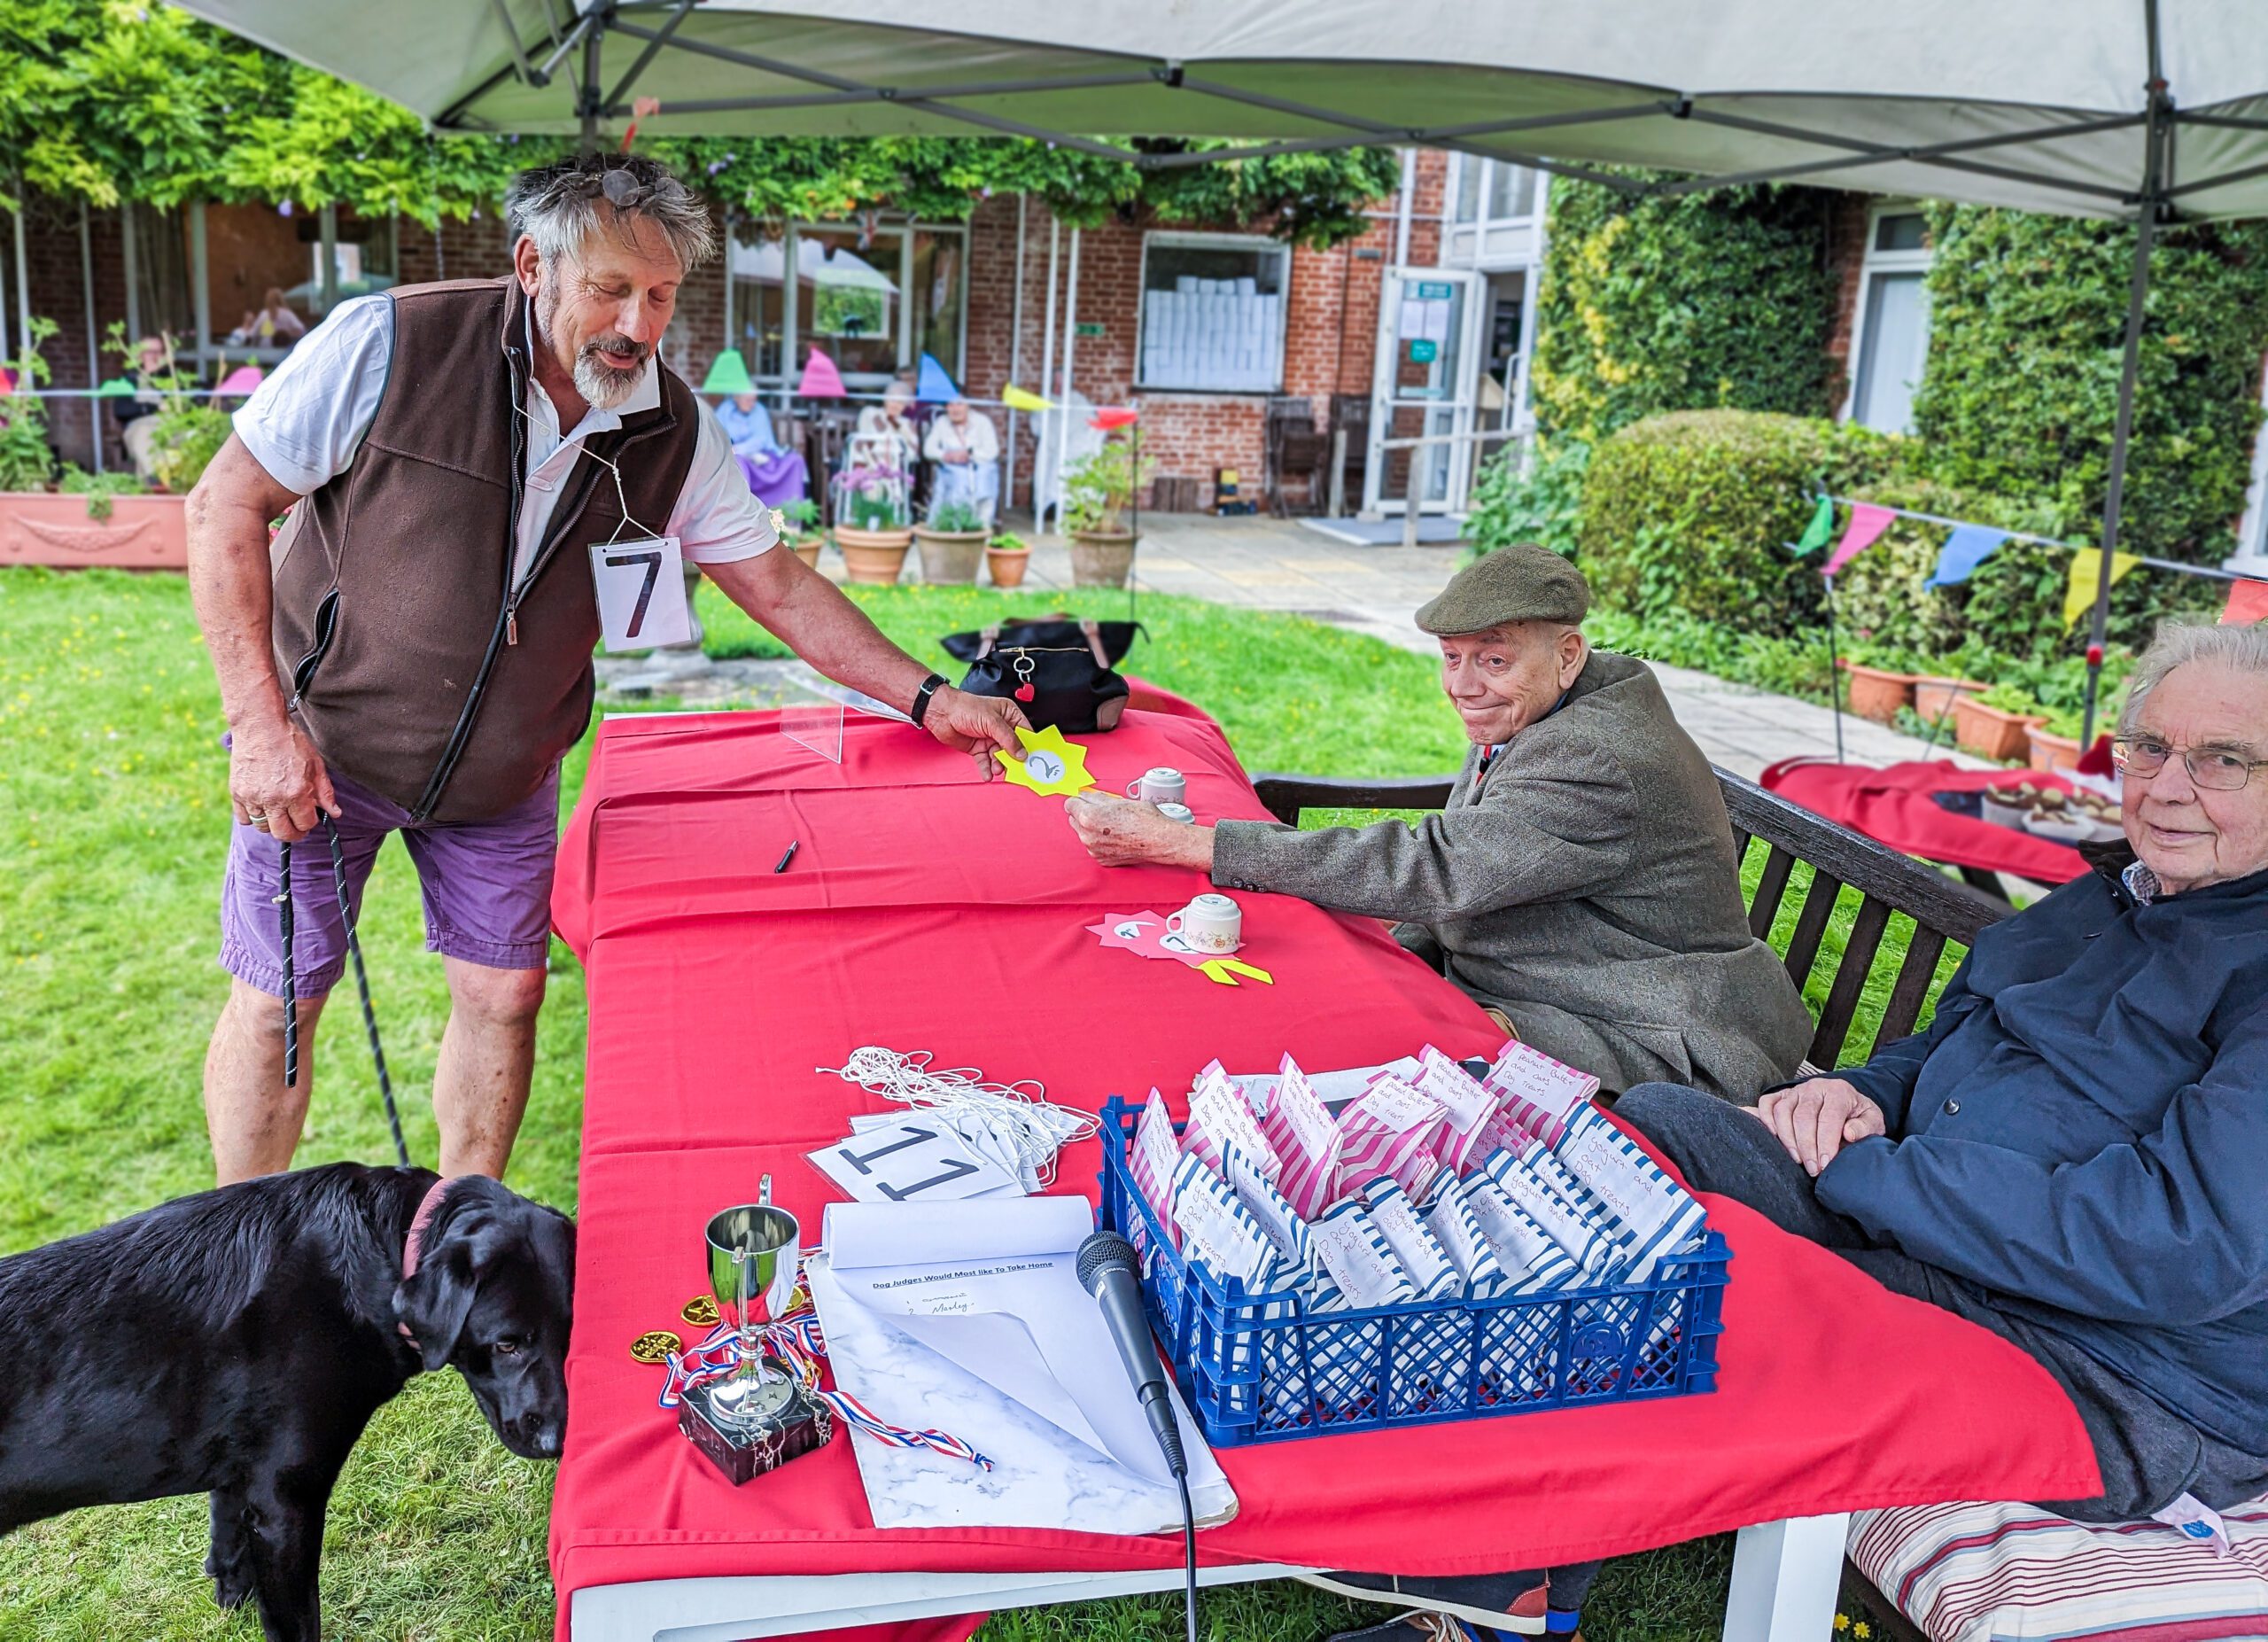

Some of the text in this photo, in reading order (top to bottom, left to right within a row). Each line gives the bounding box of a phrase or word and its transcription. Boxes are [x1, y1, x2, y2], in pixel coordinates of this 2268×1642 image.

[606, 551, 663, 638] 7
[1511, 1062, 1526, 1073] and
[1432, 1072, 1445, 1085] and
[1503, 1070, 1515, 1085] Dog
[1210, 1094, 1224, 1114] and
[1366, 1095, 1379, 1111] Dog
[1379, 1089, 1392, 1100] and
[1200, 1103, 1213, 1127] Dog
[1574, 1160, 1592, 1187] Dog
[1634, 1175, 1653, 1196] and
[1548, 1205, 1565, 1224] and
[1181, 1214, 1195, 1238] Dog
[1231, 1226, 1246, 1245] and
[1513, 1226, 1529, 1240] and
[1319, 1239, 1334, 1265] Dog
[1417, 1238, 1433, 1259] and
[892, 1278, 922, 1287] Judges
[924, 1272, 952, 1281] Would
[1371, 1263, 1386, 1279] and
